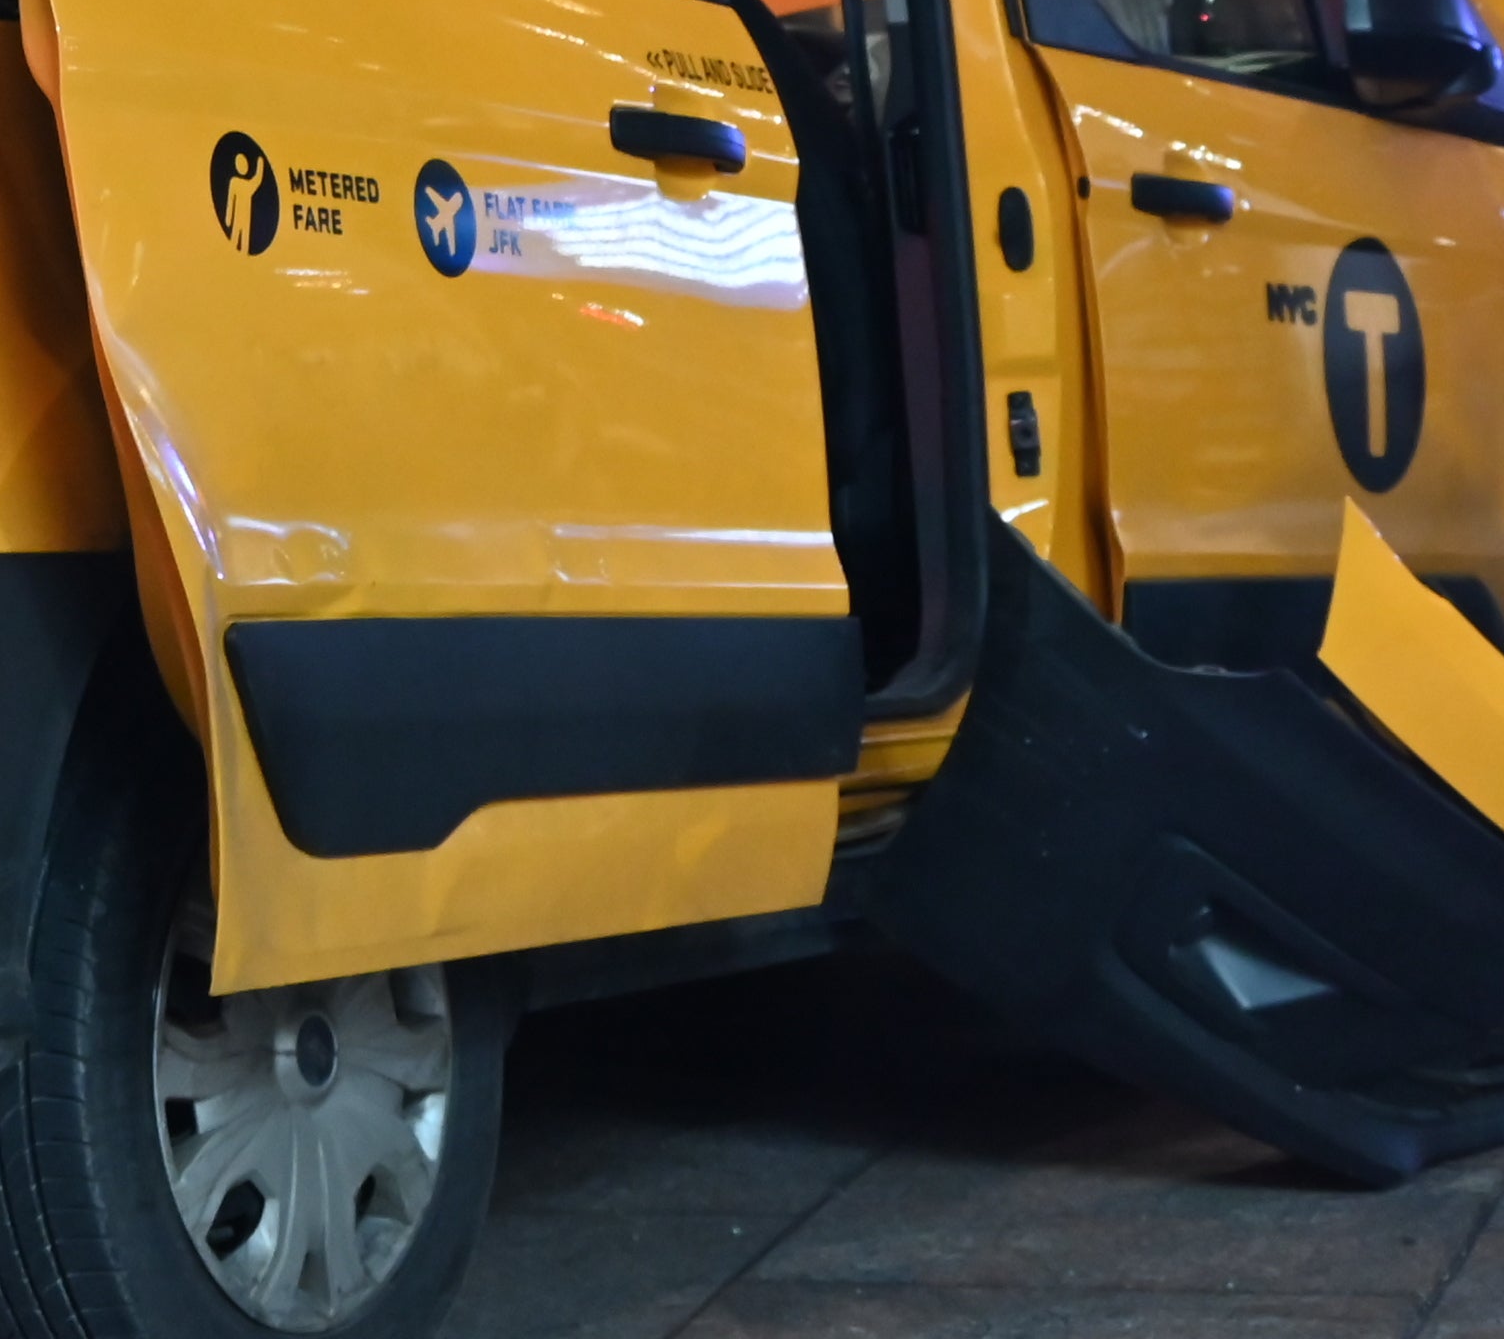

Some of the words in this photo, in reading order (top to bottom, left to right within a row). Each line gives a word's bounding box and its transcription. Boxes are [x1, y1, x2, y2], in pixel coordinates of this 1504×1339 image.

[662, 49, 703, 81] PULL
[700, 57, 733, 86] AND
[289, 167, 380, 204] METERED
[293, 204, 344, 235] FARE
[484, 191, 526, 220] FLAT
[488, 229, 523, 257] JFK
[1265, 281, 1318, 326] NYC
